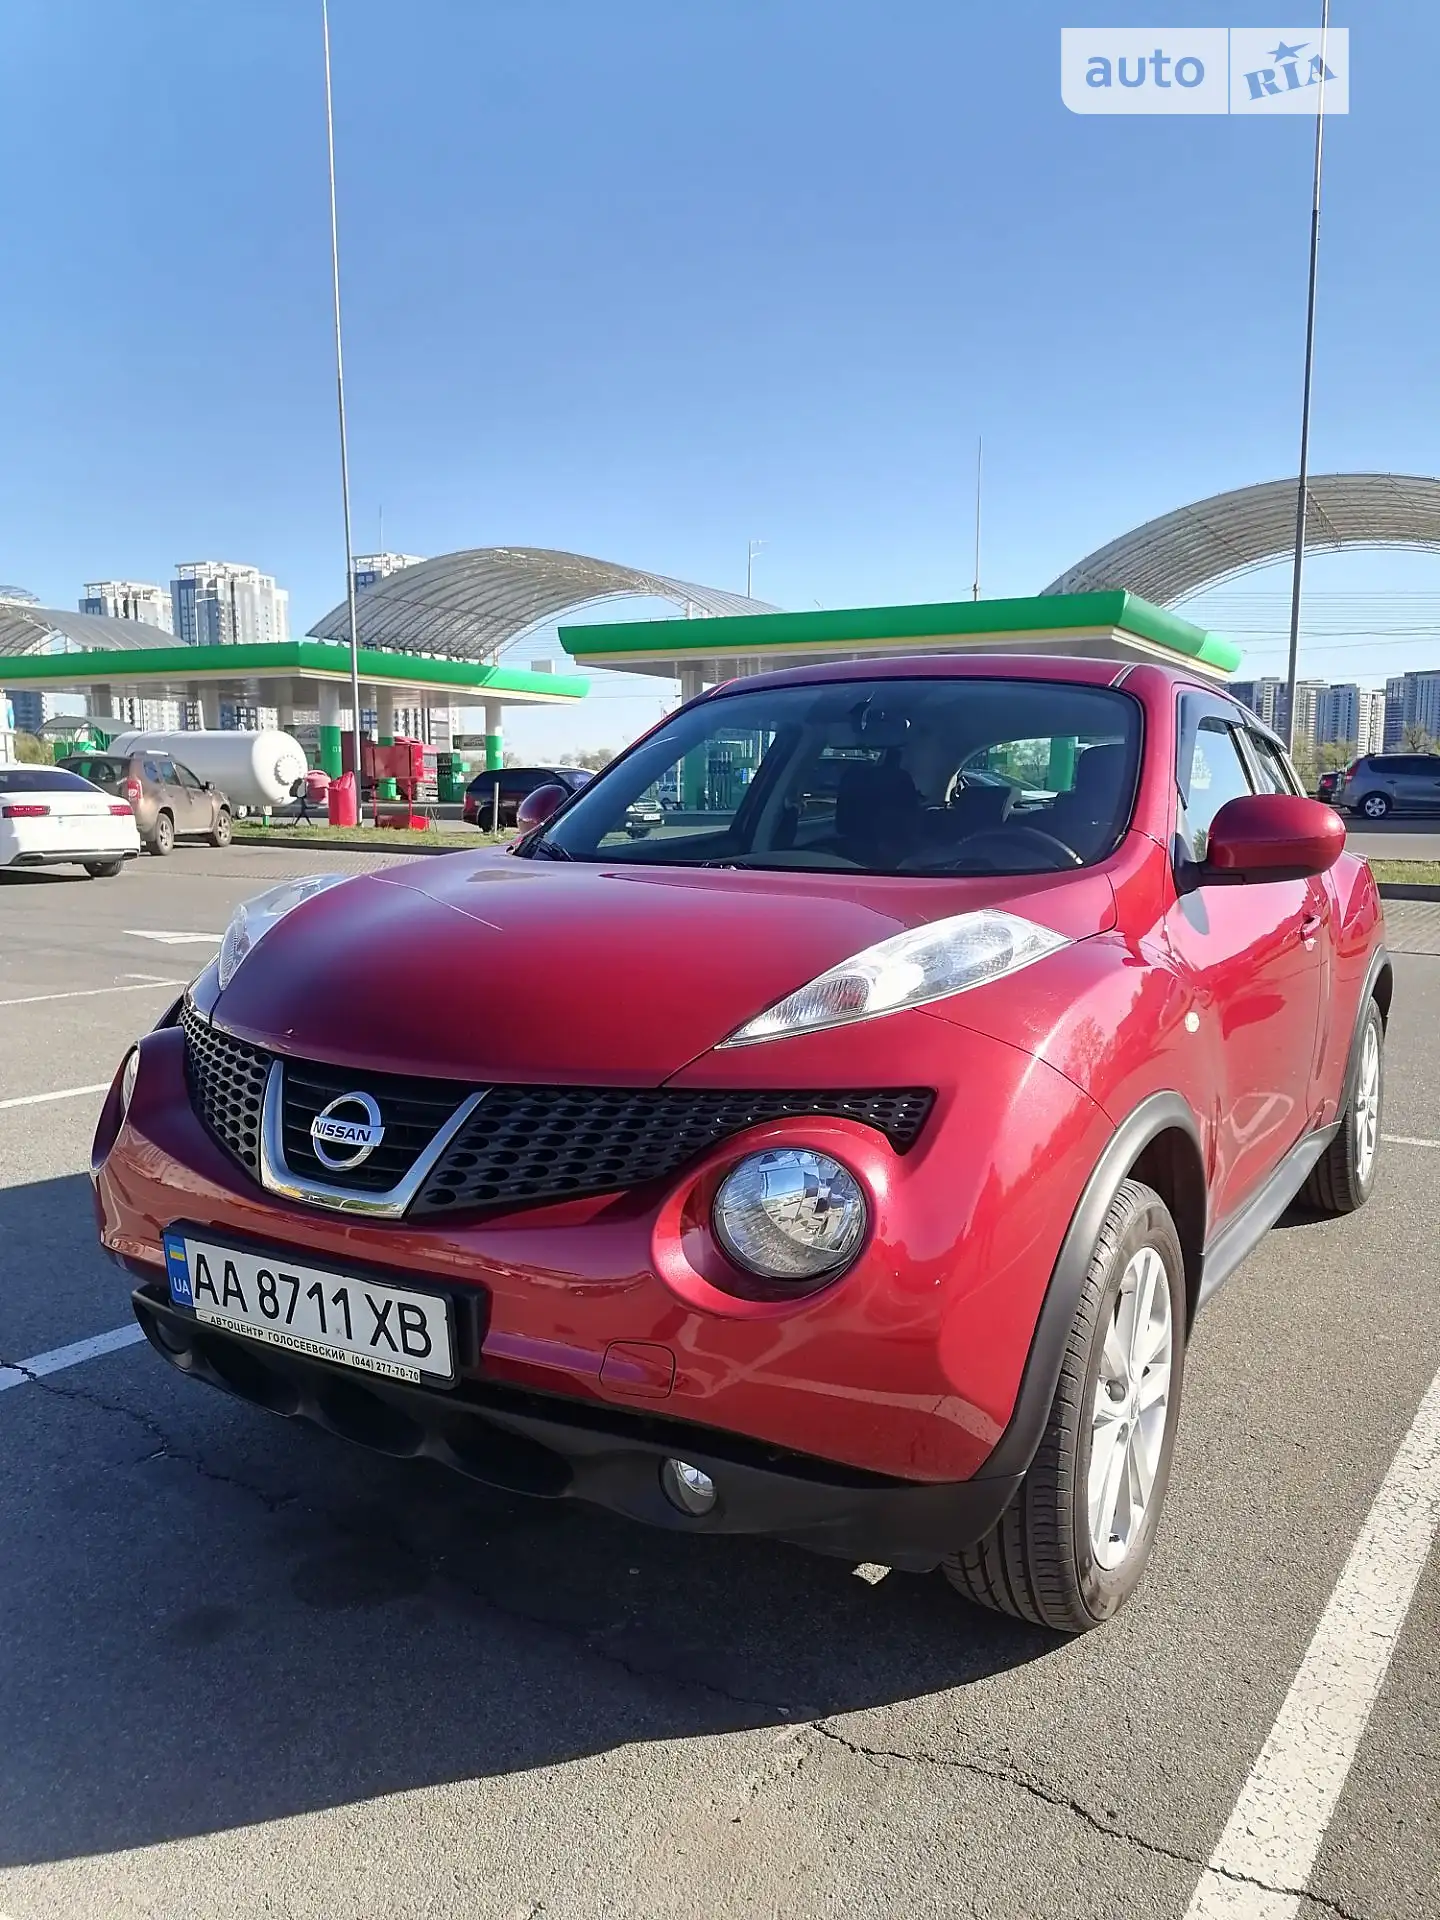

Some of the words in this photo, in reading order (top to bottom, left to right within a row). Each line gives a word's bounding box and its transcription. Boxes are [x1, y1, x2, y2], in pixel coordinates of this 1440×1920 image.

[313, 1120, 372, 1142] NISSAN
[173, 1277, 190, 1296] UA
[194, 1254, 249, 1312] AA
[257, 1269, 353, 1340] 8711
[365, 1294, 432, 1358] XB
[210, 1314, 265, 1340] АВТОЦЕНТР
[268, 1331, 346, 1362] ГОЛОСЕЕВСКИЙ
[351, 1355, 375, 1370] (044)
[376, 1361, 420, 1382] 277-70-70
